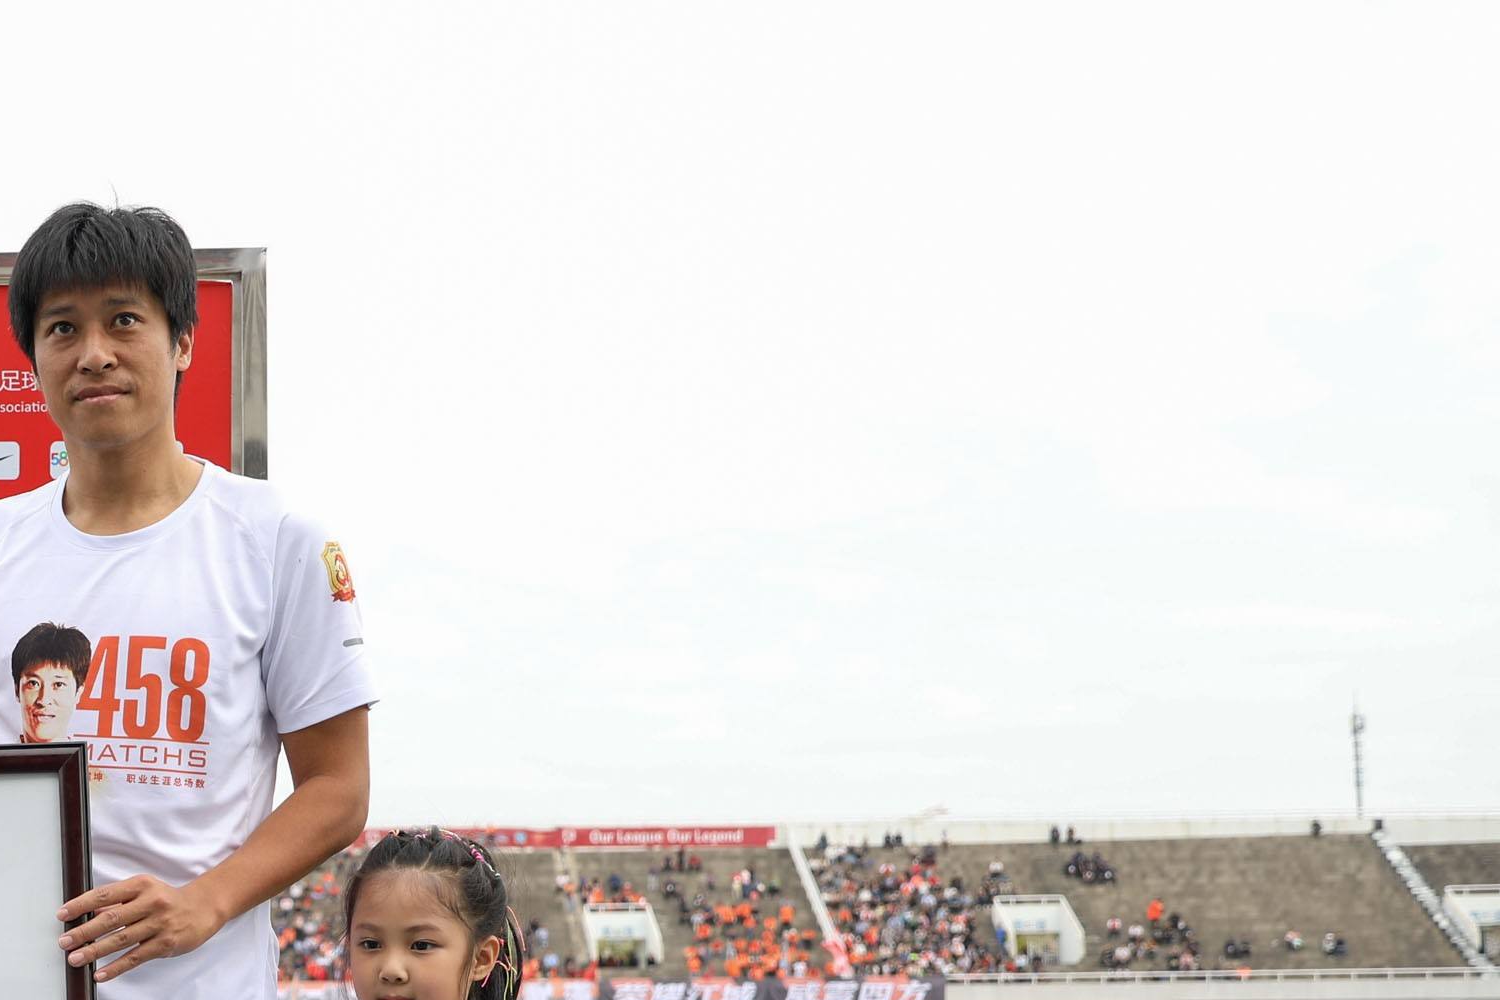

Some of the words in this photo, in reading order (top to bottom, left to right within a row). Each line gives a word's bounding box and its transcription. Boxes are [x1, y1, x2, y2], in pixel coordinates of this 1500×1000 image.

[76, 635, 210, 743] 458
[126, 773, 205, 789] 职业生涯总场数
